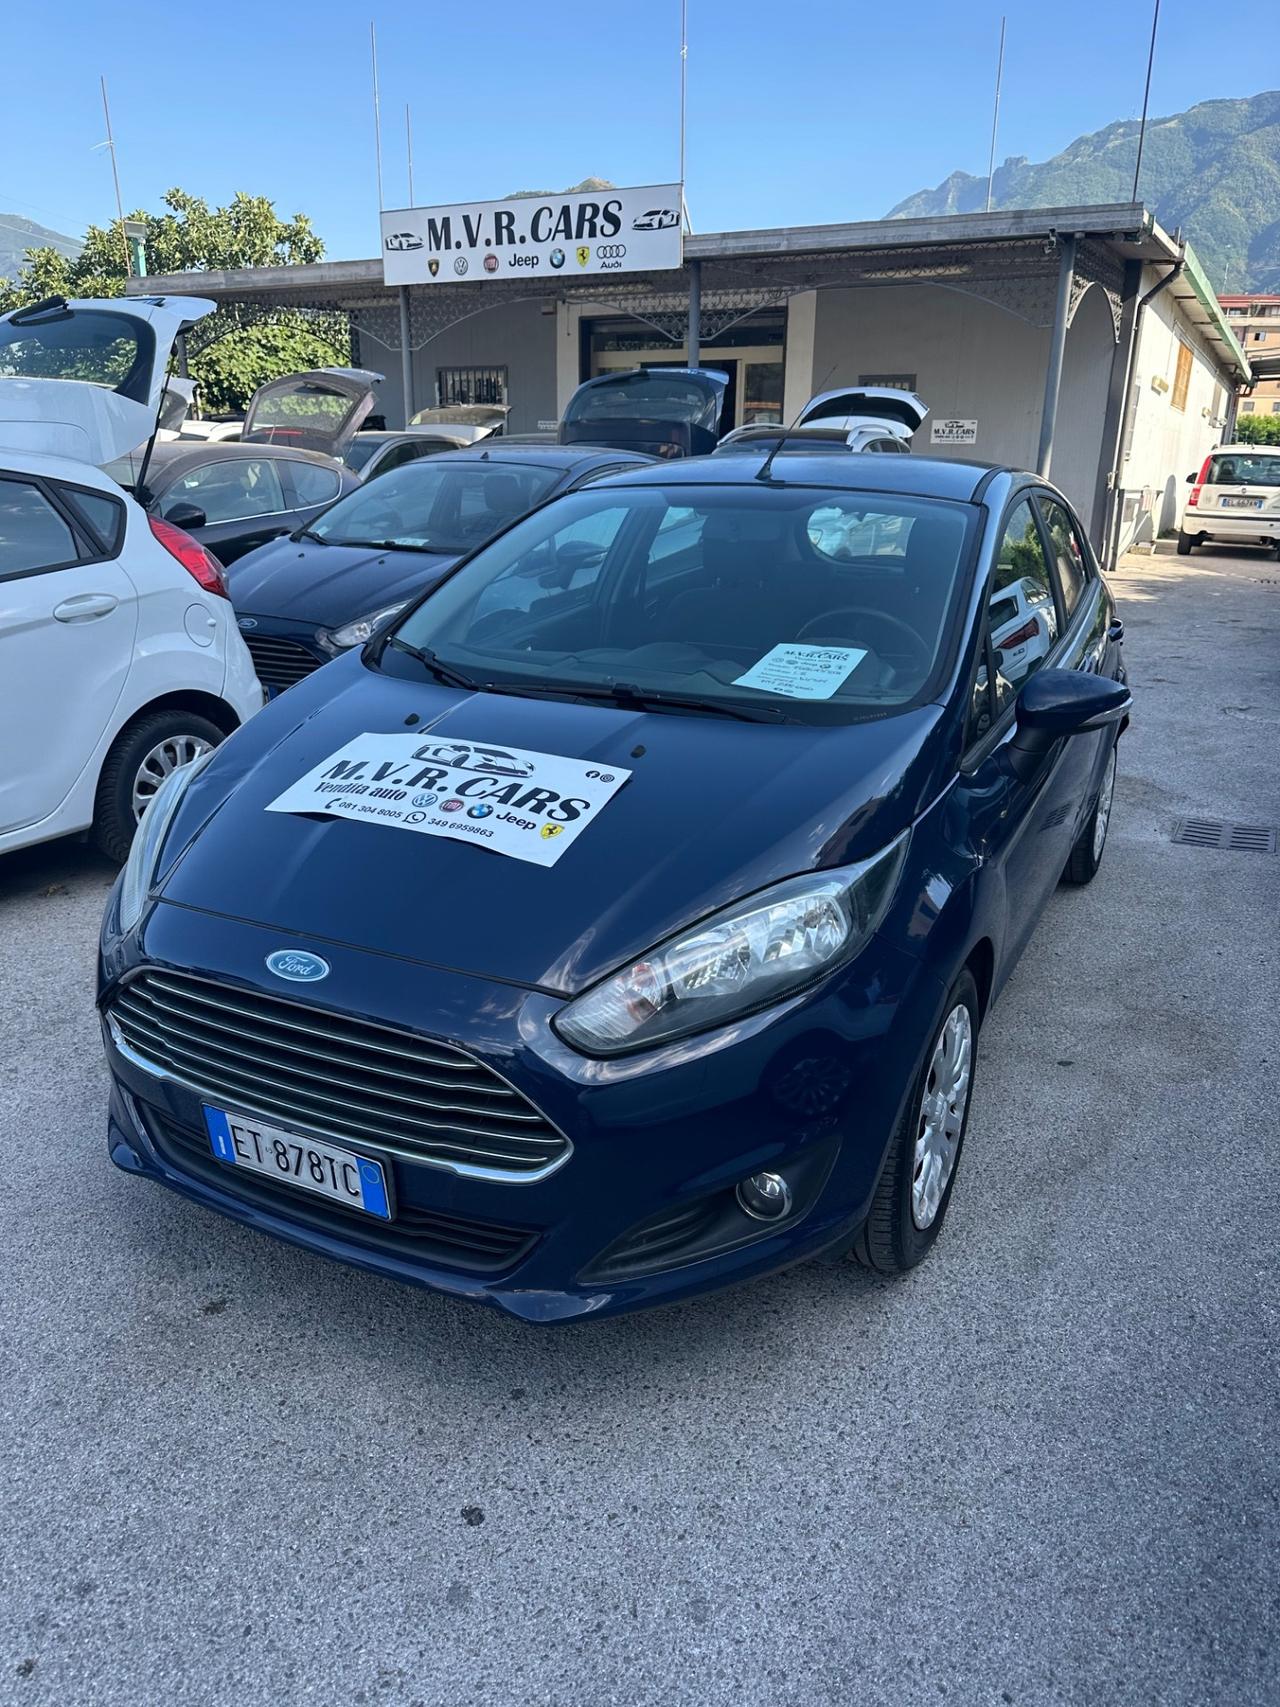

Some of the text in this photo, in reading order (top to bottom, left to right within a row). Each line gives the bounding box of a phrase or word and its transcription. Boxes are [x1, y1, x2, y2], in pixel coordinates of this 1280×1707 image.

[509, 253, 539, 268] Jeep
[600, 261, 622, 269] Audi
[314, 782, 408, 801] Vendita auto
[338, 801, 404, 818] 081 304 8005
[428, 818, 494, 838] 349 6959863
[496, 812, 536, 830] Jeep
[278, 954, 313, 976] Ford
[231, 1124, 262, 1163] ET
